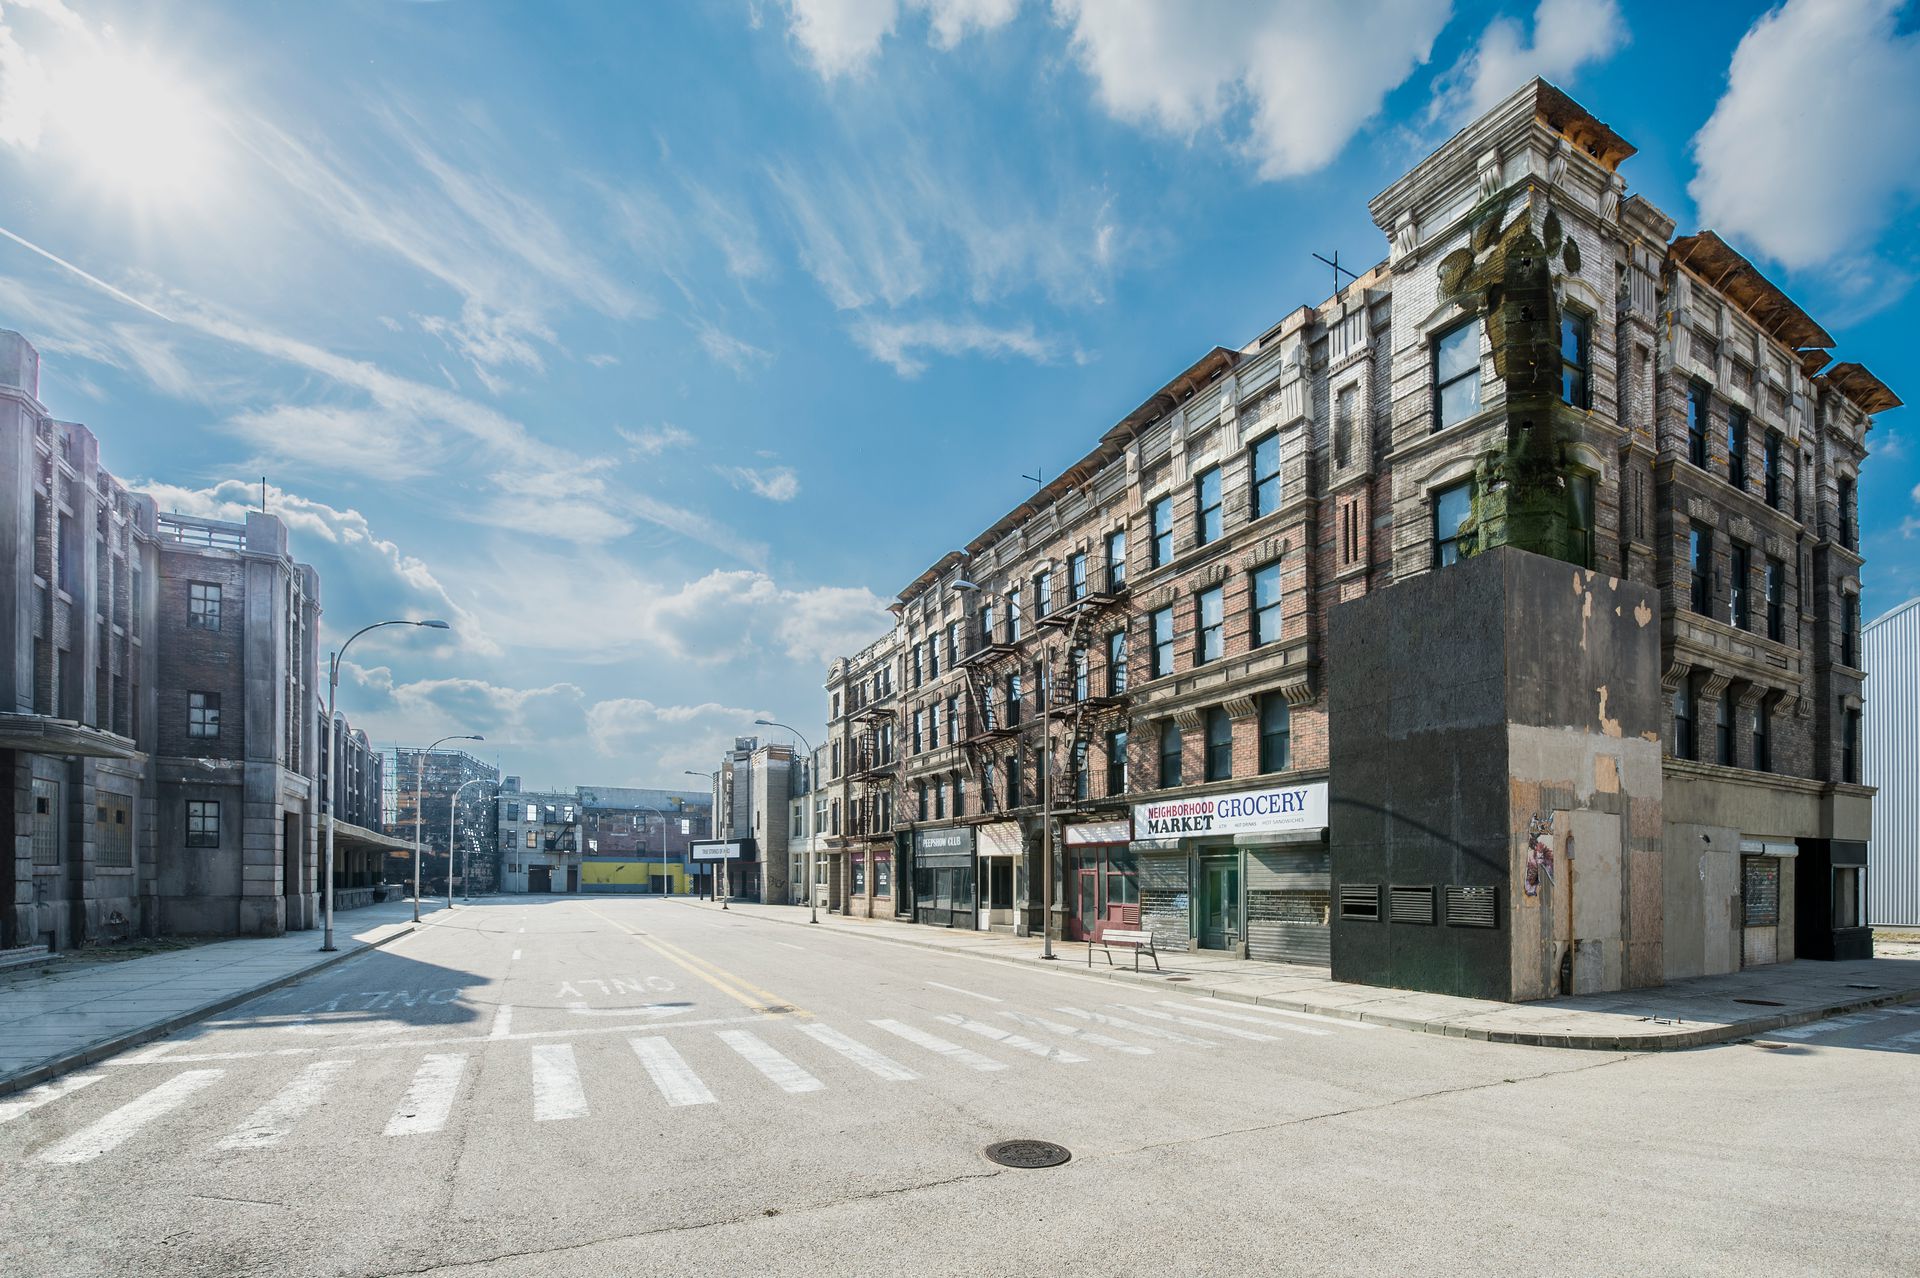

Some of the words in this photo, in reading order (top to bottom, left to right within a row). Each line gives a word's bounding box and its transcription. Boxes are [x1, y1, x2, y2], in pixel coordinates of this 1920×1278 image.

[1148, 801, 1214, 819] NEIGHBORHOOD
[1217, 790, 1308, 818] GROCERY
[1147, 814, 1214, 834] MARKET
[947, 836, 961, 846] CLUB
[555, 975, 676, 998] ONLY
